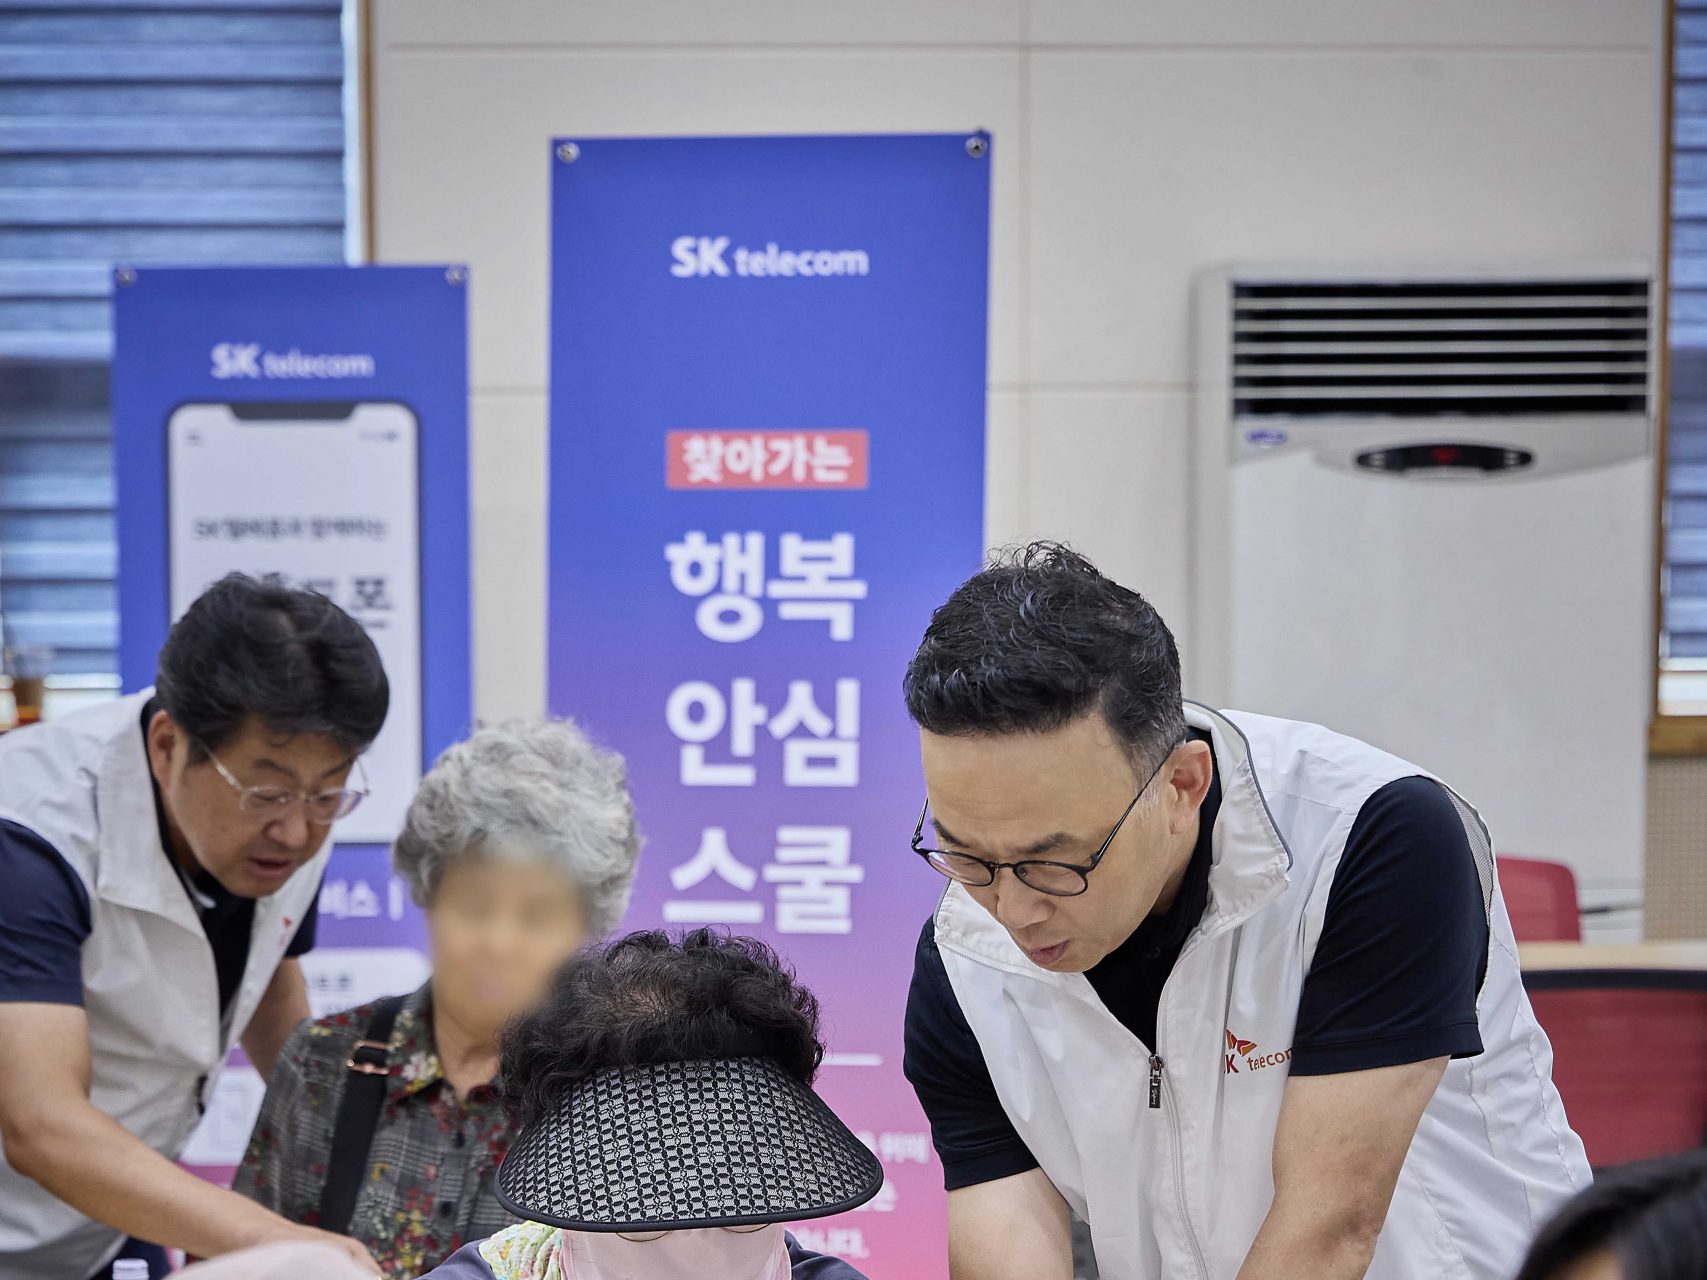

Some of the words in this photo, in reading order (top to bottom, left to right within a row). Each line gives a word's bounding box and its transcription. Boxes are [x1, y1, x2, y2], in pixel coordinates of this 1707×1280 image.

[670, 237, 730, 277] SK
[734, 243, 869, 276] telecom
[211, 343, 262, 379] SK
[264, 347, 375, 378] telecom
[683, 434, 852, 482] 찾아가는
[664, 531, 868, 643] 행복
[665, 677, 861, 787] 안심
[318, 878, 380, 918] 비스
[663, 824, 865, 935] 스쿨
[1224, 1053, 1240, 1074] K
